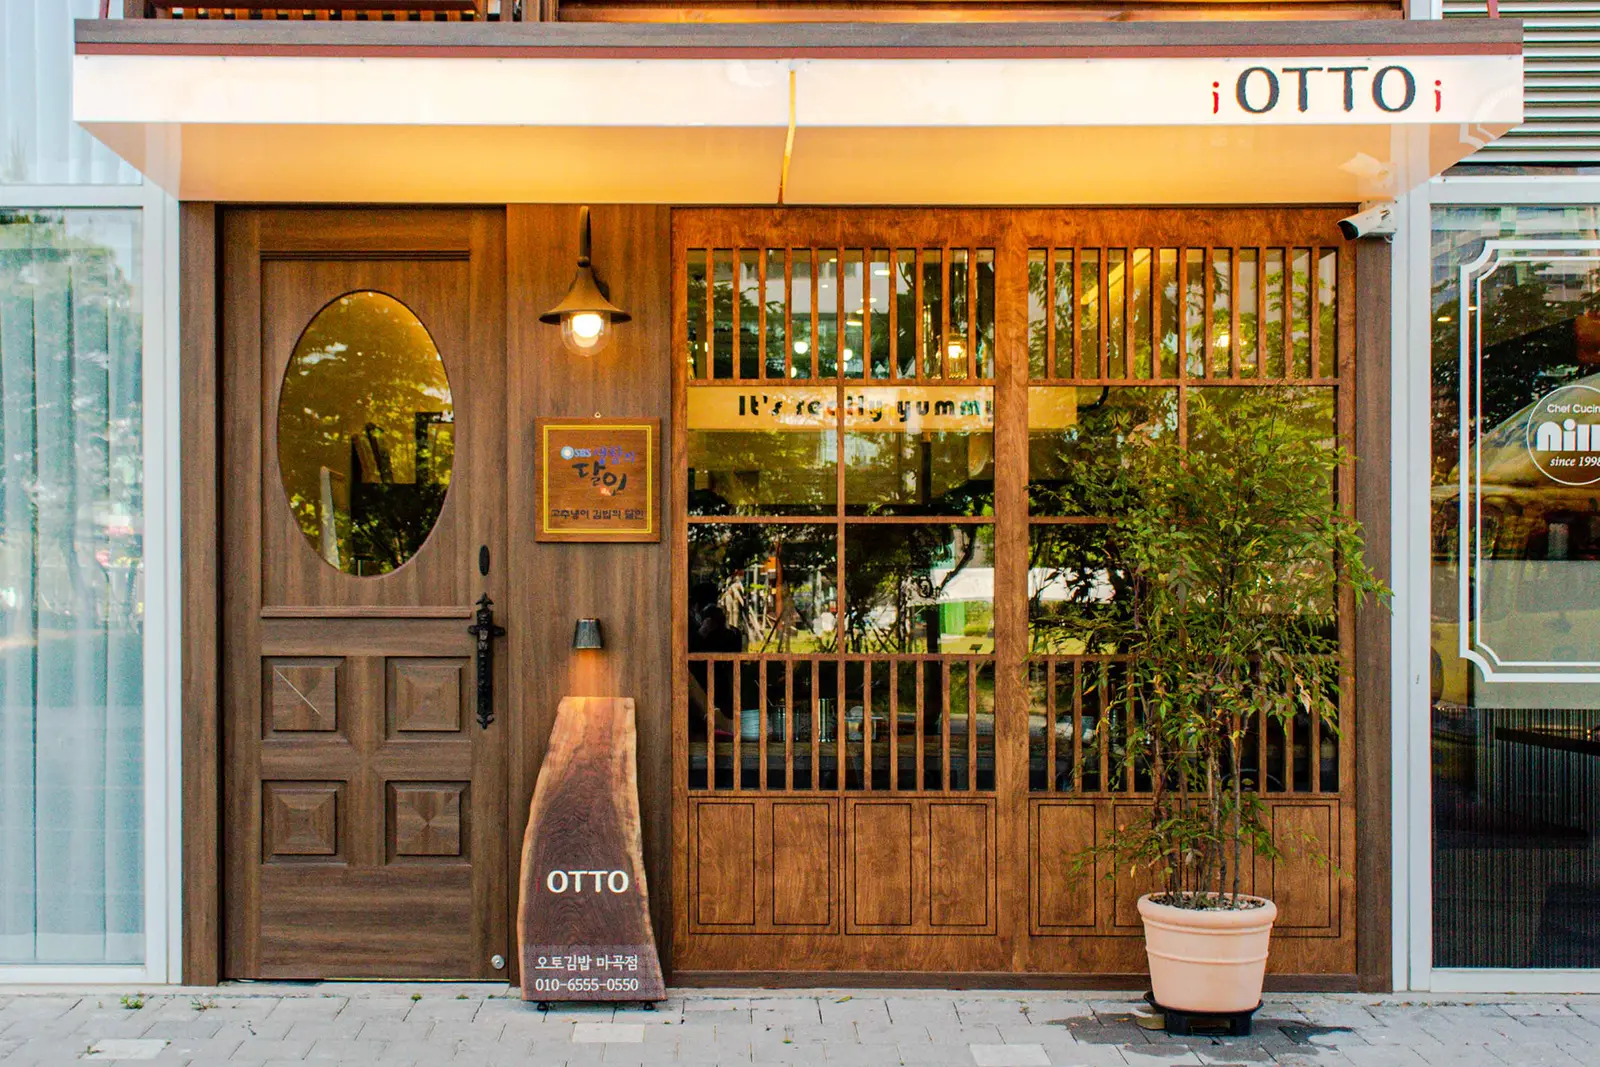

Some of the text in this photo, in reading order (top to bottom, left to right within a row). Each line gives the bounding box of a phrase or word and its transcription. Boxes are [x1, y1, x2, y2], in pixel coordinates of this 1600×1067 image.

[1235, 65, 1417, 114] OTTO
[1547, 403, 1571, 413] Chef
[1550, 456, 1576, 467] since
[546, 869, 629, 894] OTTO
[535, 954, 638, 971] 오토김밥 마곡점
[535, 978, 639, 991] 010-6555-0550
